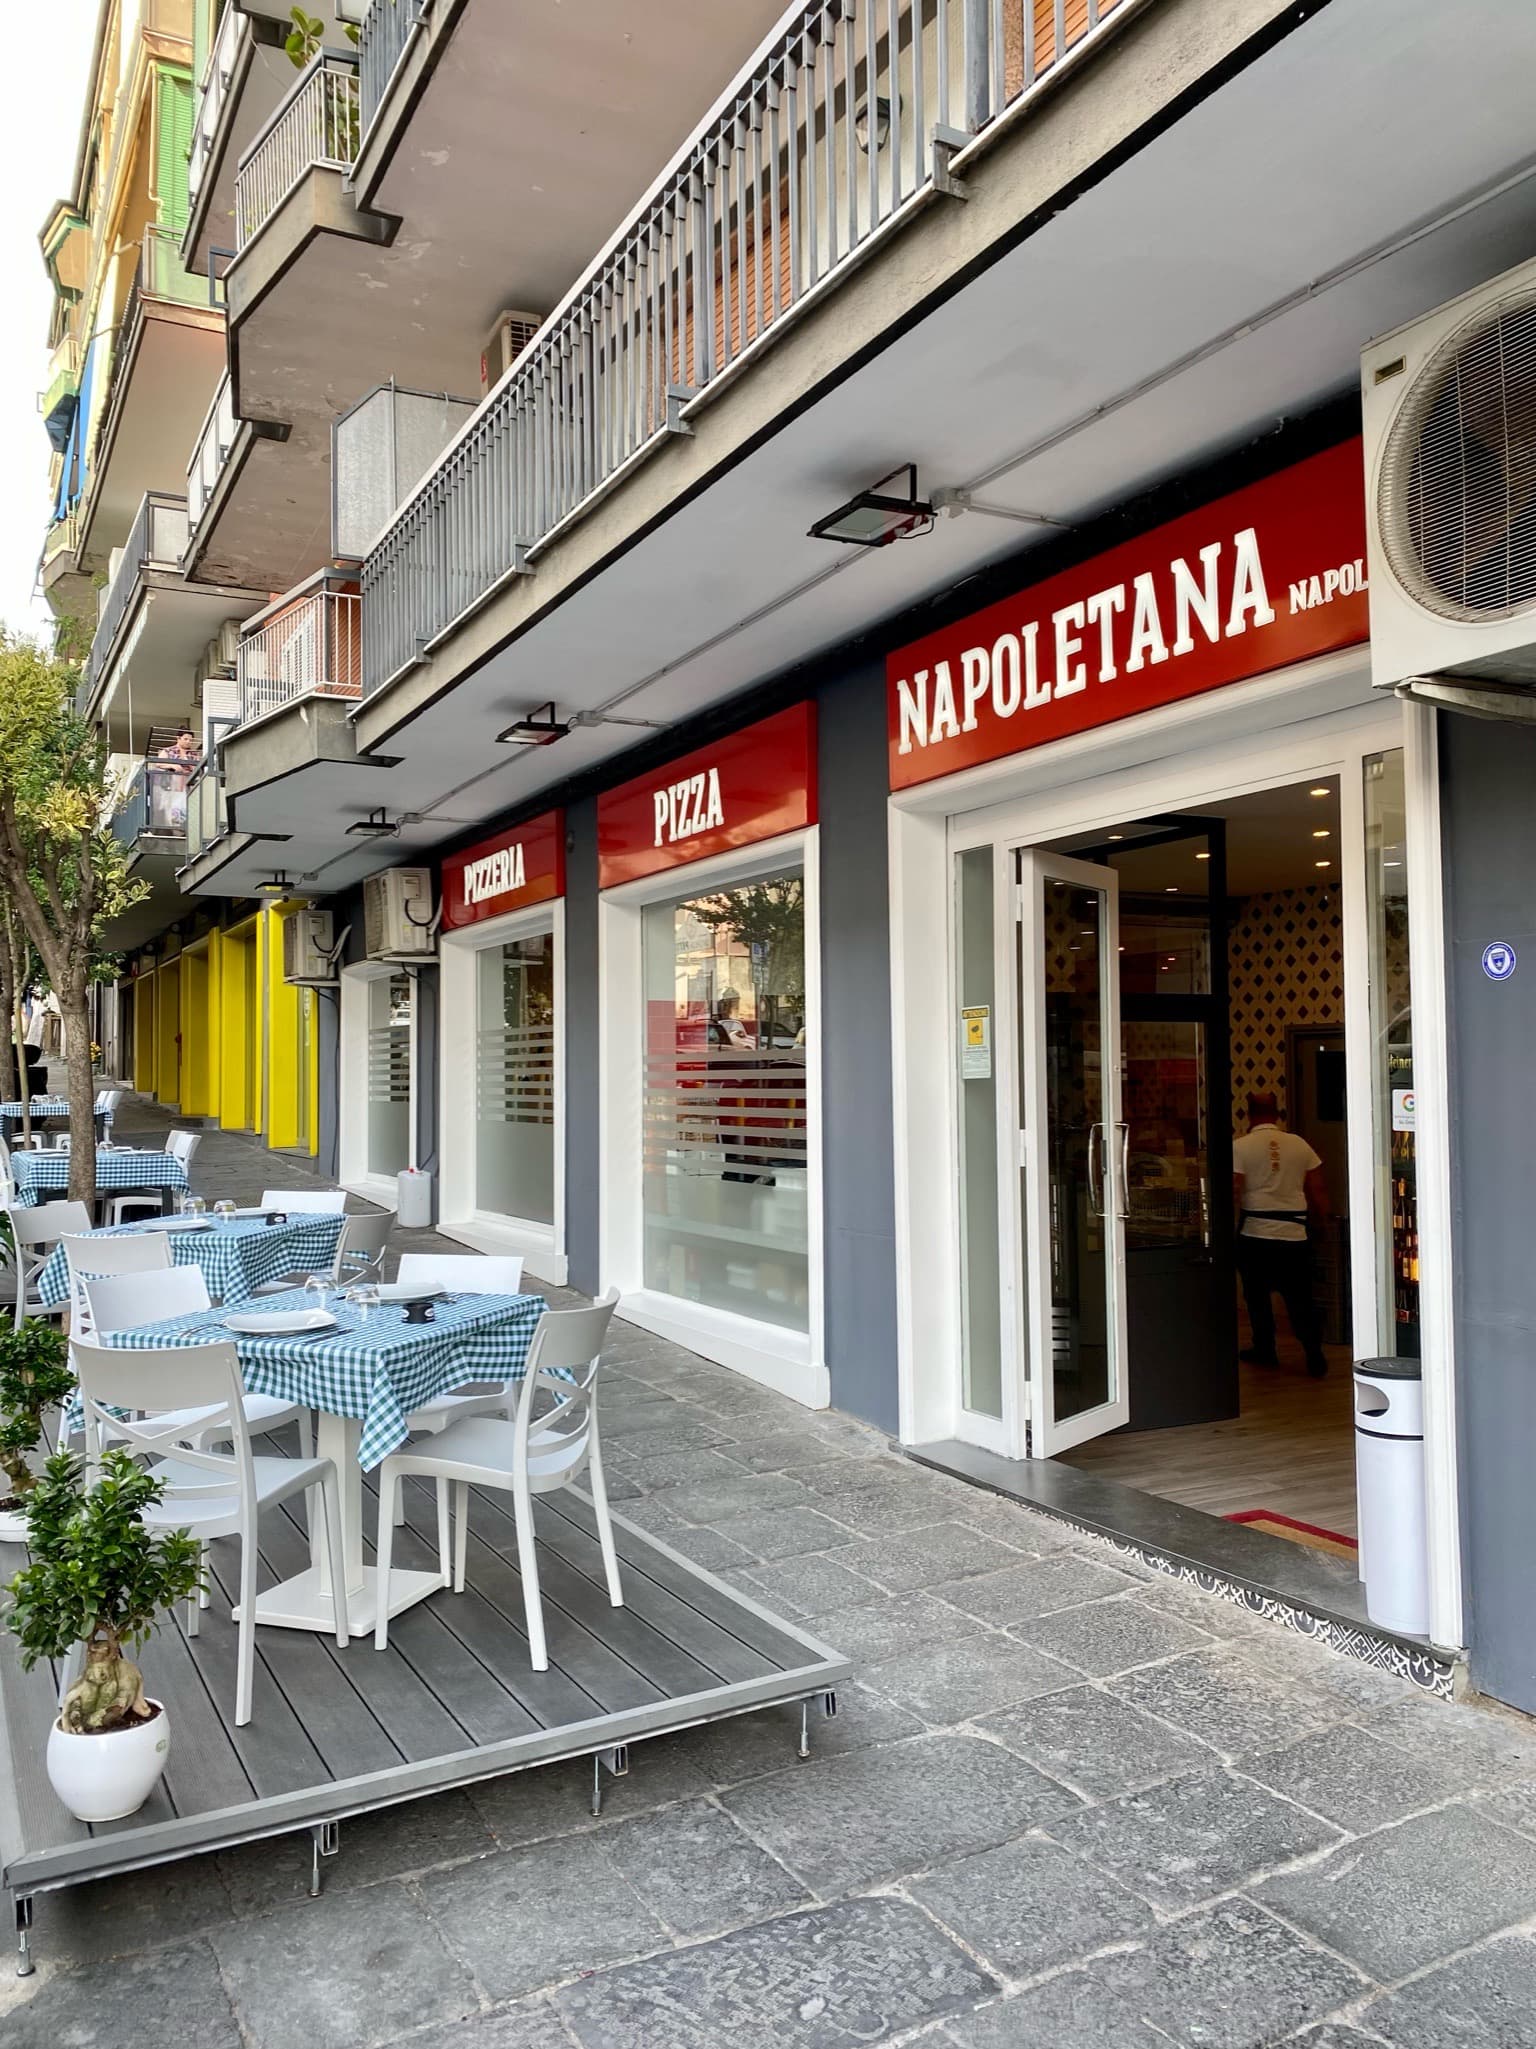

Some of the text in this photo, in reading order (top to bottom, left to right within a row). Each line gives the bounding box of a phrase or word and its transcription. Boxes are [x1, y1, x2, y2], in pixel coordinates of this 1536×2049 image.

[897, 527, 1369, 756] NAPOLETANA NAPOL
[653, 767, 725, 847] PIZZA
[463, 842, 526, 906] PIZZERIA
